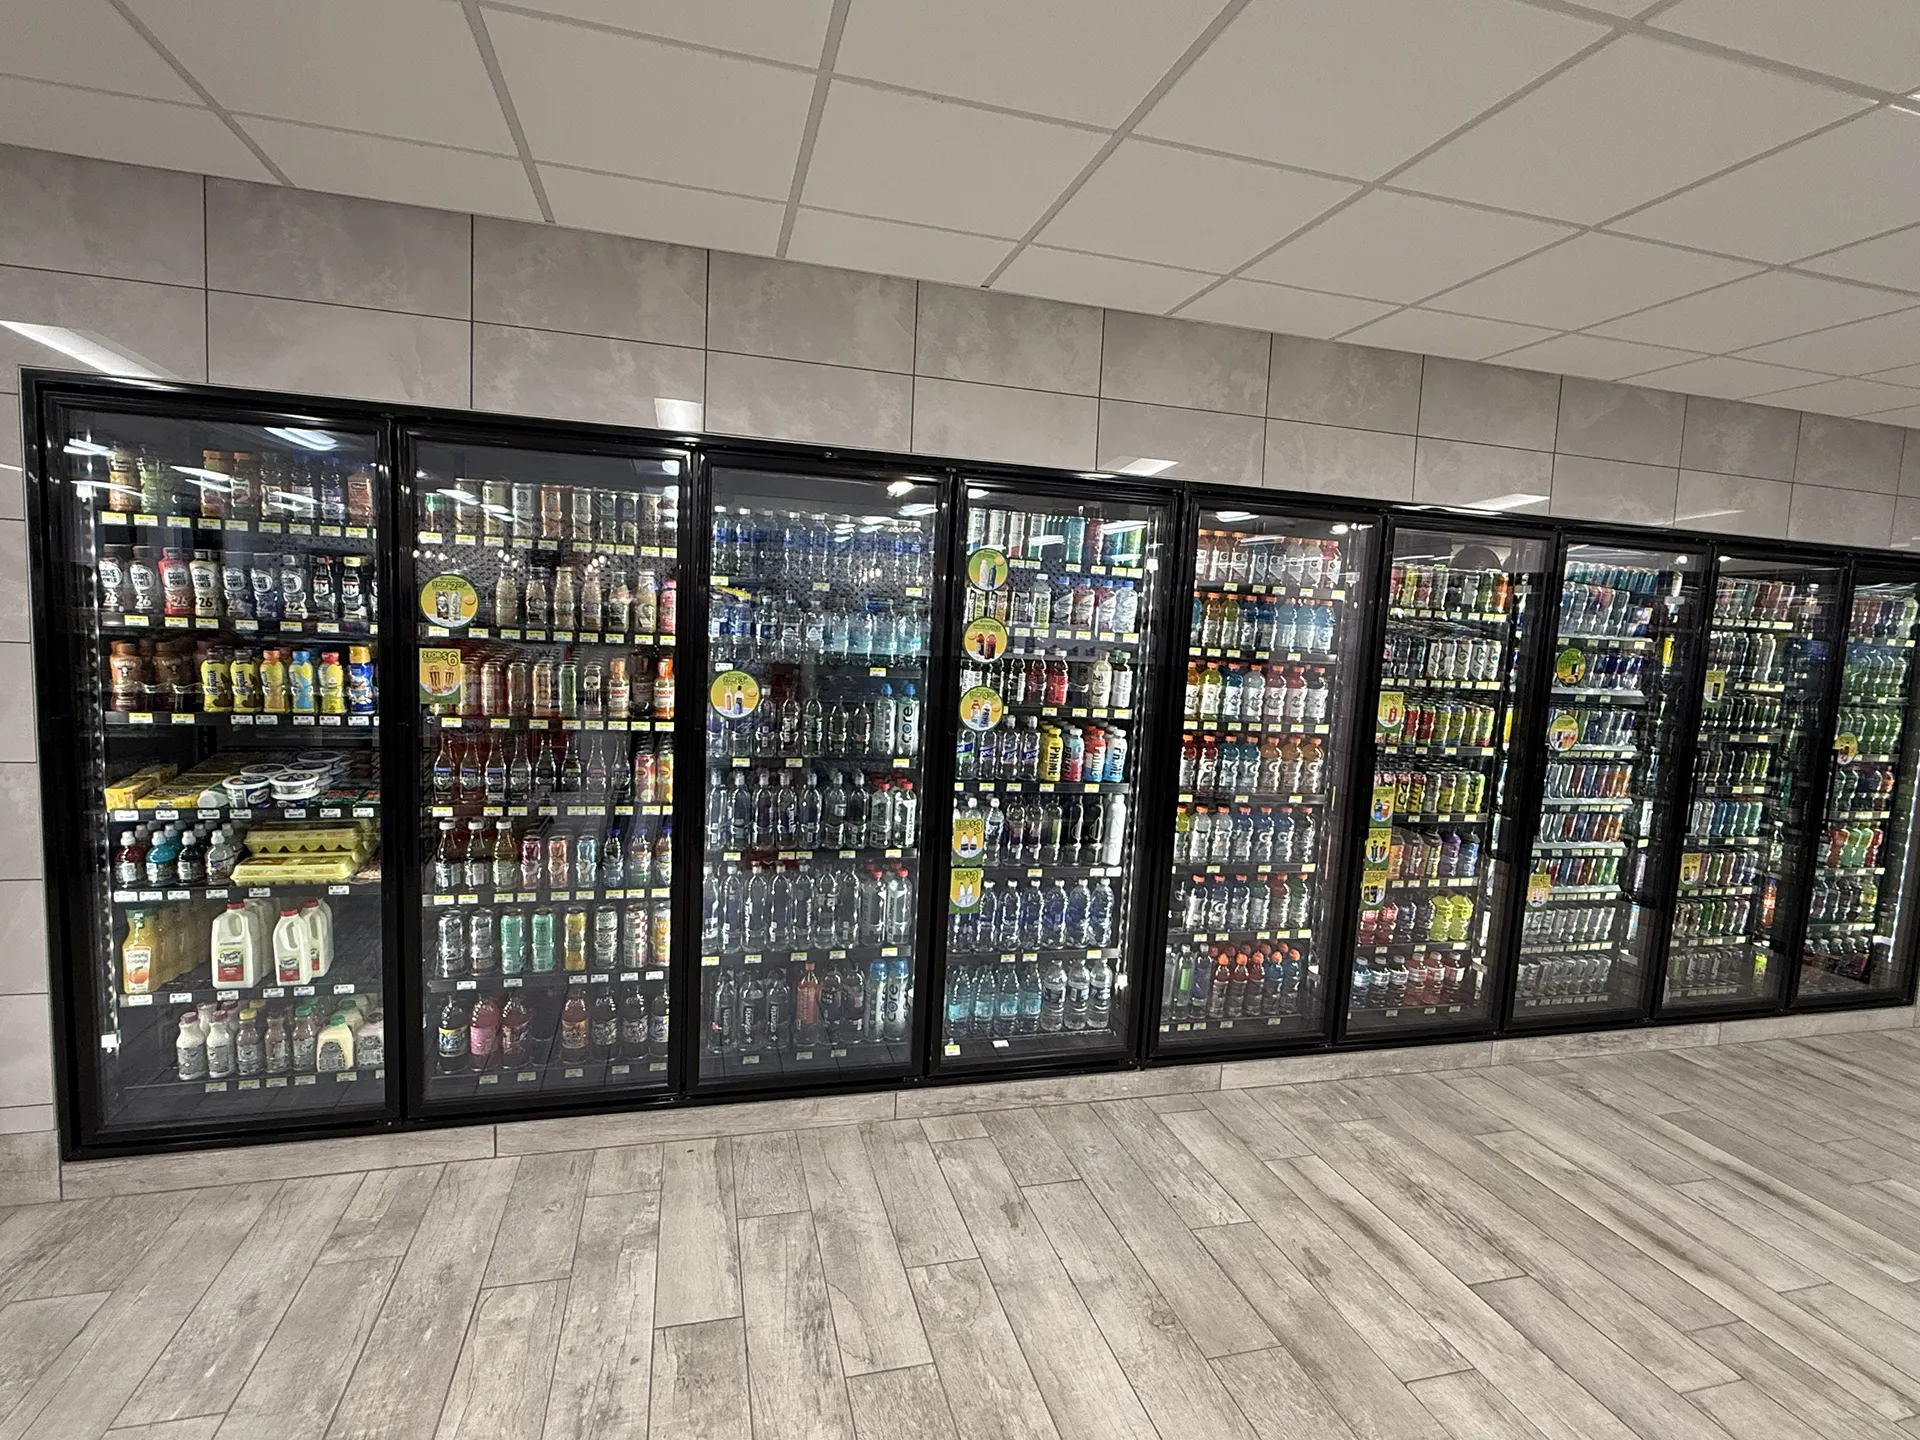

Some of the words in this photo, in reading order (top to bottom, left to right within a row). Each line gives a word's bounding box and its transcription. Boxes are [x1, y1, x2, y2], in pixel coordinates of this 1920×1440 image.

[104, 592, 118, 604] 26
[136, 595, 152, 607] 26
[198, 597, 213, 608] 26
[783, 716, 792, 743] smart
[901, 705, 914, 744] core
[1048, 746, 1061, 777] PRIME
[1258, 831, 1270, 843] G
[1277, 831, 1288, 842] G
[887, 982, 899, 1023] core
[744, 1006, 753, 1035] essentia
